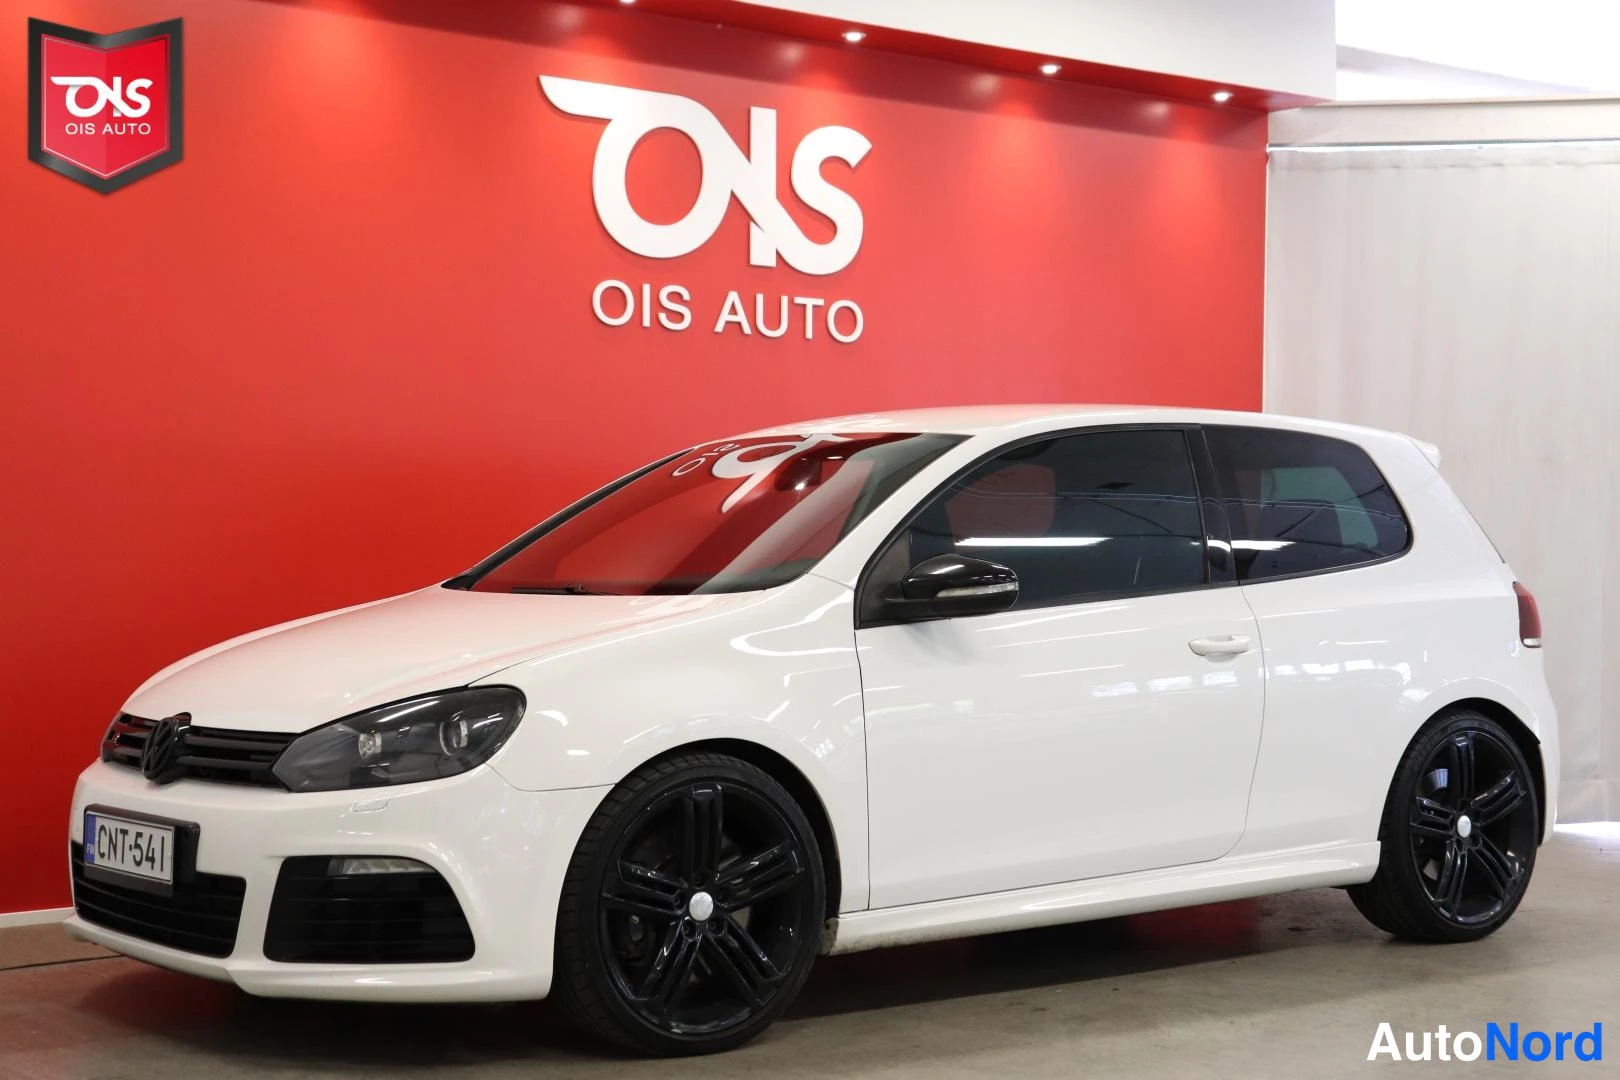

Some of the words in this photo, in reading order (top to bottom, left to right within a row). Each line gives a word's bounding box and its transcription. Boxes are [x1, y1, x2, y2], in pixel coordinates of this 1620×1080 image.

[592, 279, 692, 331] OIS
[714, 290, 864, 343] AUTO
[97, 824, 165, 872] CNT-541
